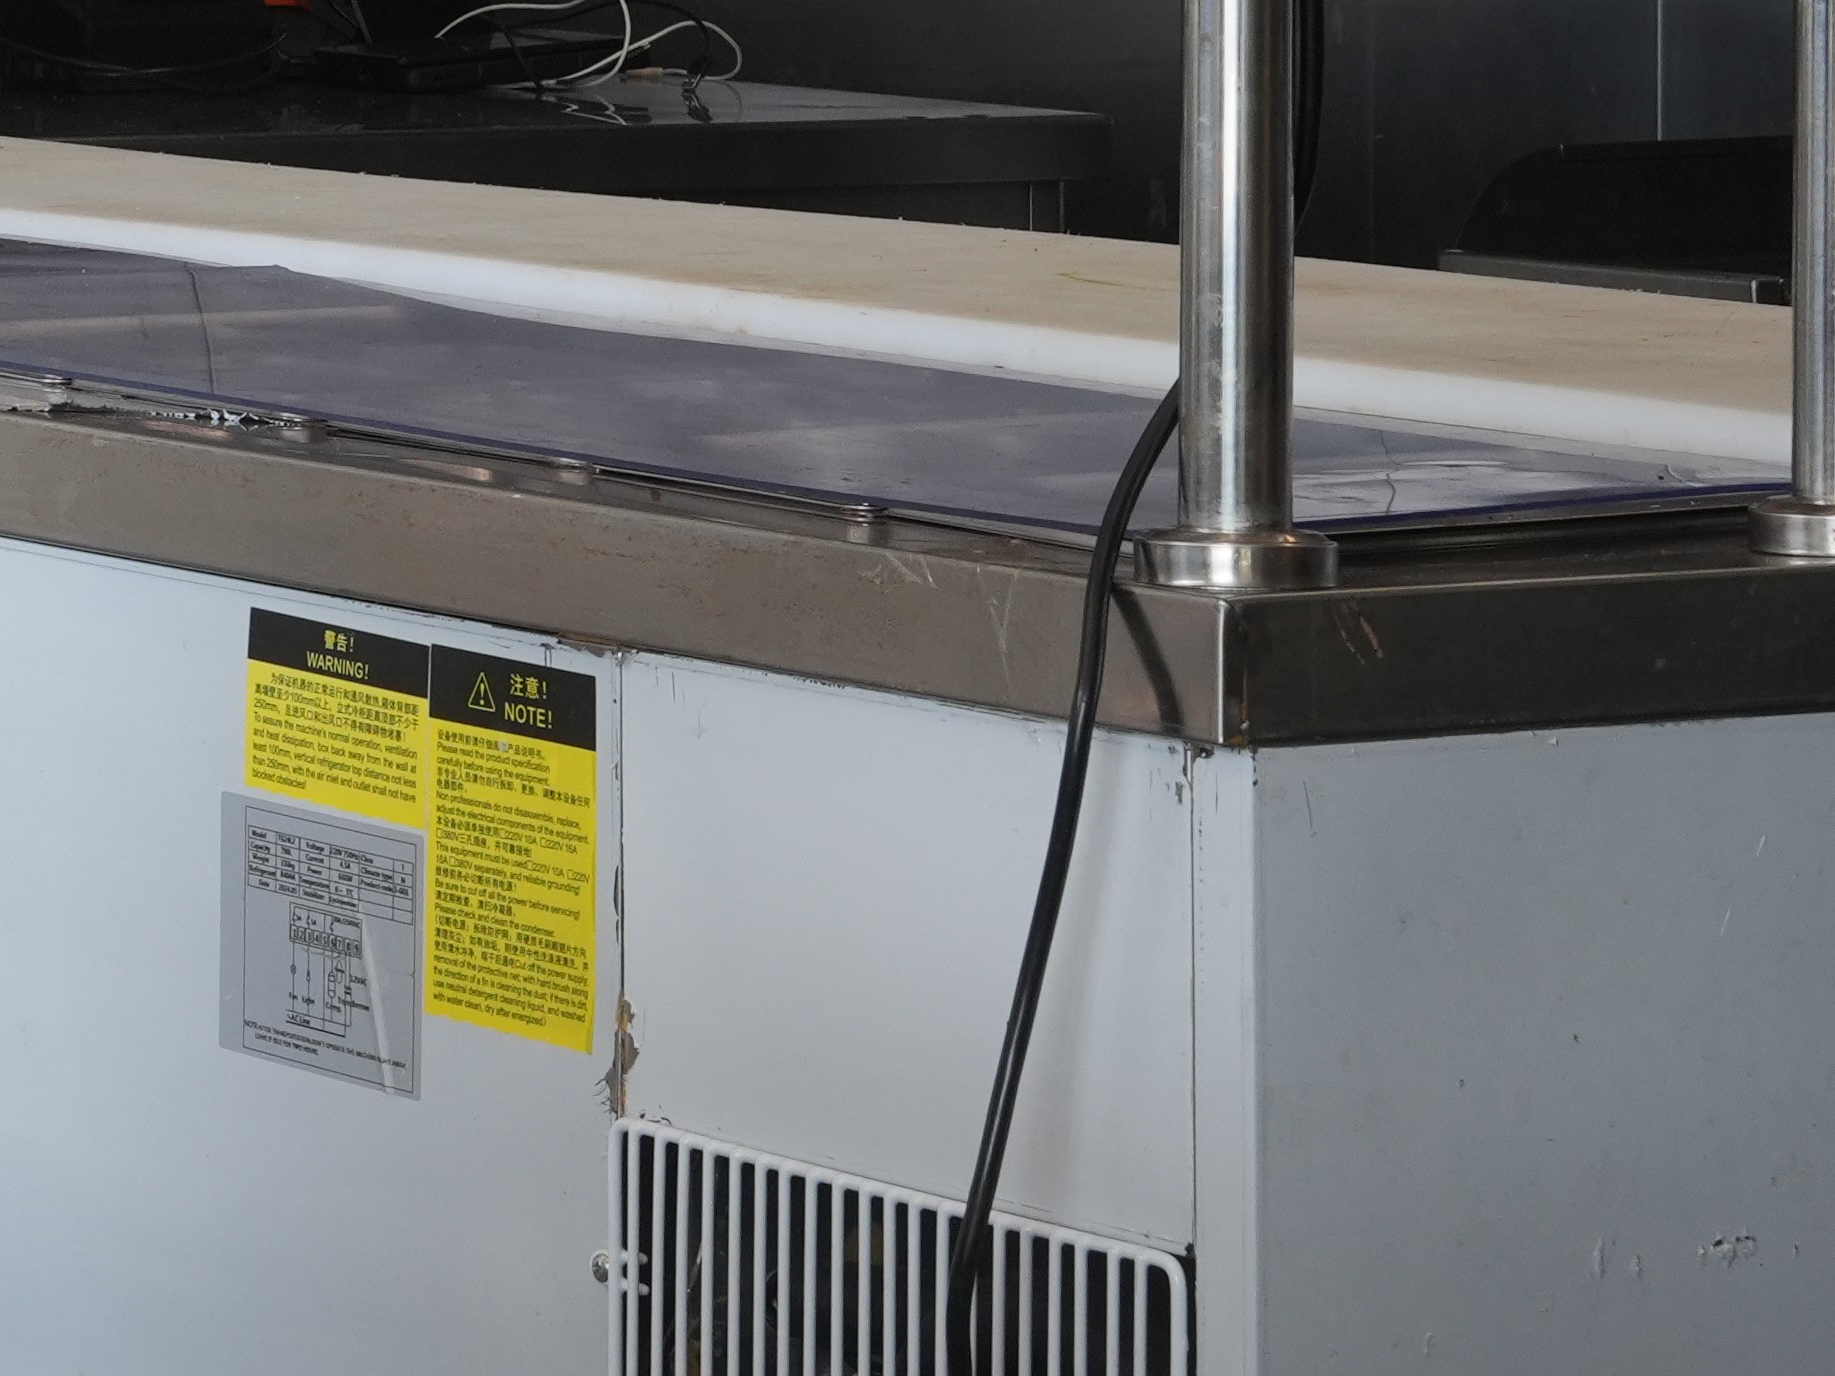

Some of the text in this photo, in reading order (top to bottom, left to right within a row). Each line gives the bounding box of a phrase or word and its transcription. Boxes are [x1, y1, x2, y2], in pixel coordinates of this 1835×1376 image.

[307, 651, 369, 680] WARNING!
[509, 673, 547, 699] 注意!
[504, 701, 552, 729] NOTE!
[253, 728, 264, 738] and
[266, 729, 279, 741] heat
[317, 742, 329, 753] box
[331, 744, 346, 756] back
[348, 750, 365, 763] away
[366, 753, 381, 765] from
[383, 758, 393, 769] the
[395, 762, 408, 771] wall
[254, 711, 261, 723] To
[284, 719, 294, 730] the
[328, 731, 350, 743] normal
[385, 744, 418, 759] ventilation
[253, 741, 417, 788] least vertical refrigerator top distance not less
[437, 742, 457, 754] Please
[459, 746, 473, 758] read
[474, 749, 485, 760] the
[486, 752, 510, 766] product
[253, 755, 416, 803] than with the air inlet and outlet shall not have
[463, 761, 483, 773] before
[504, 768, 514, 779] the
